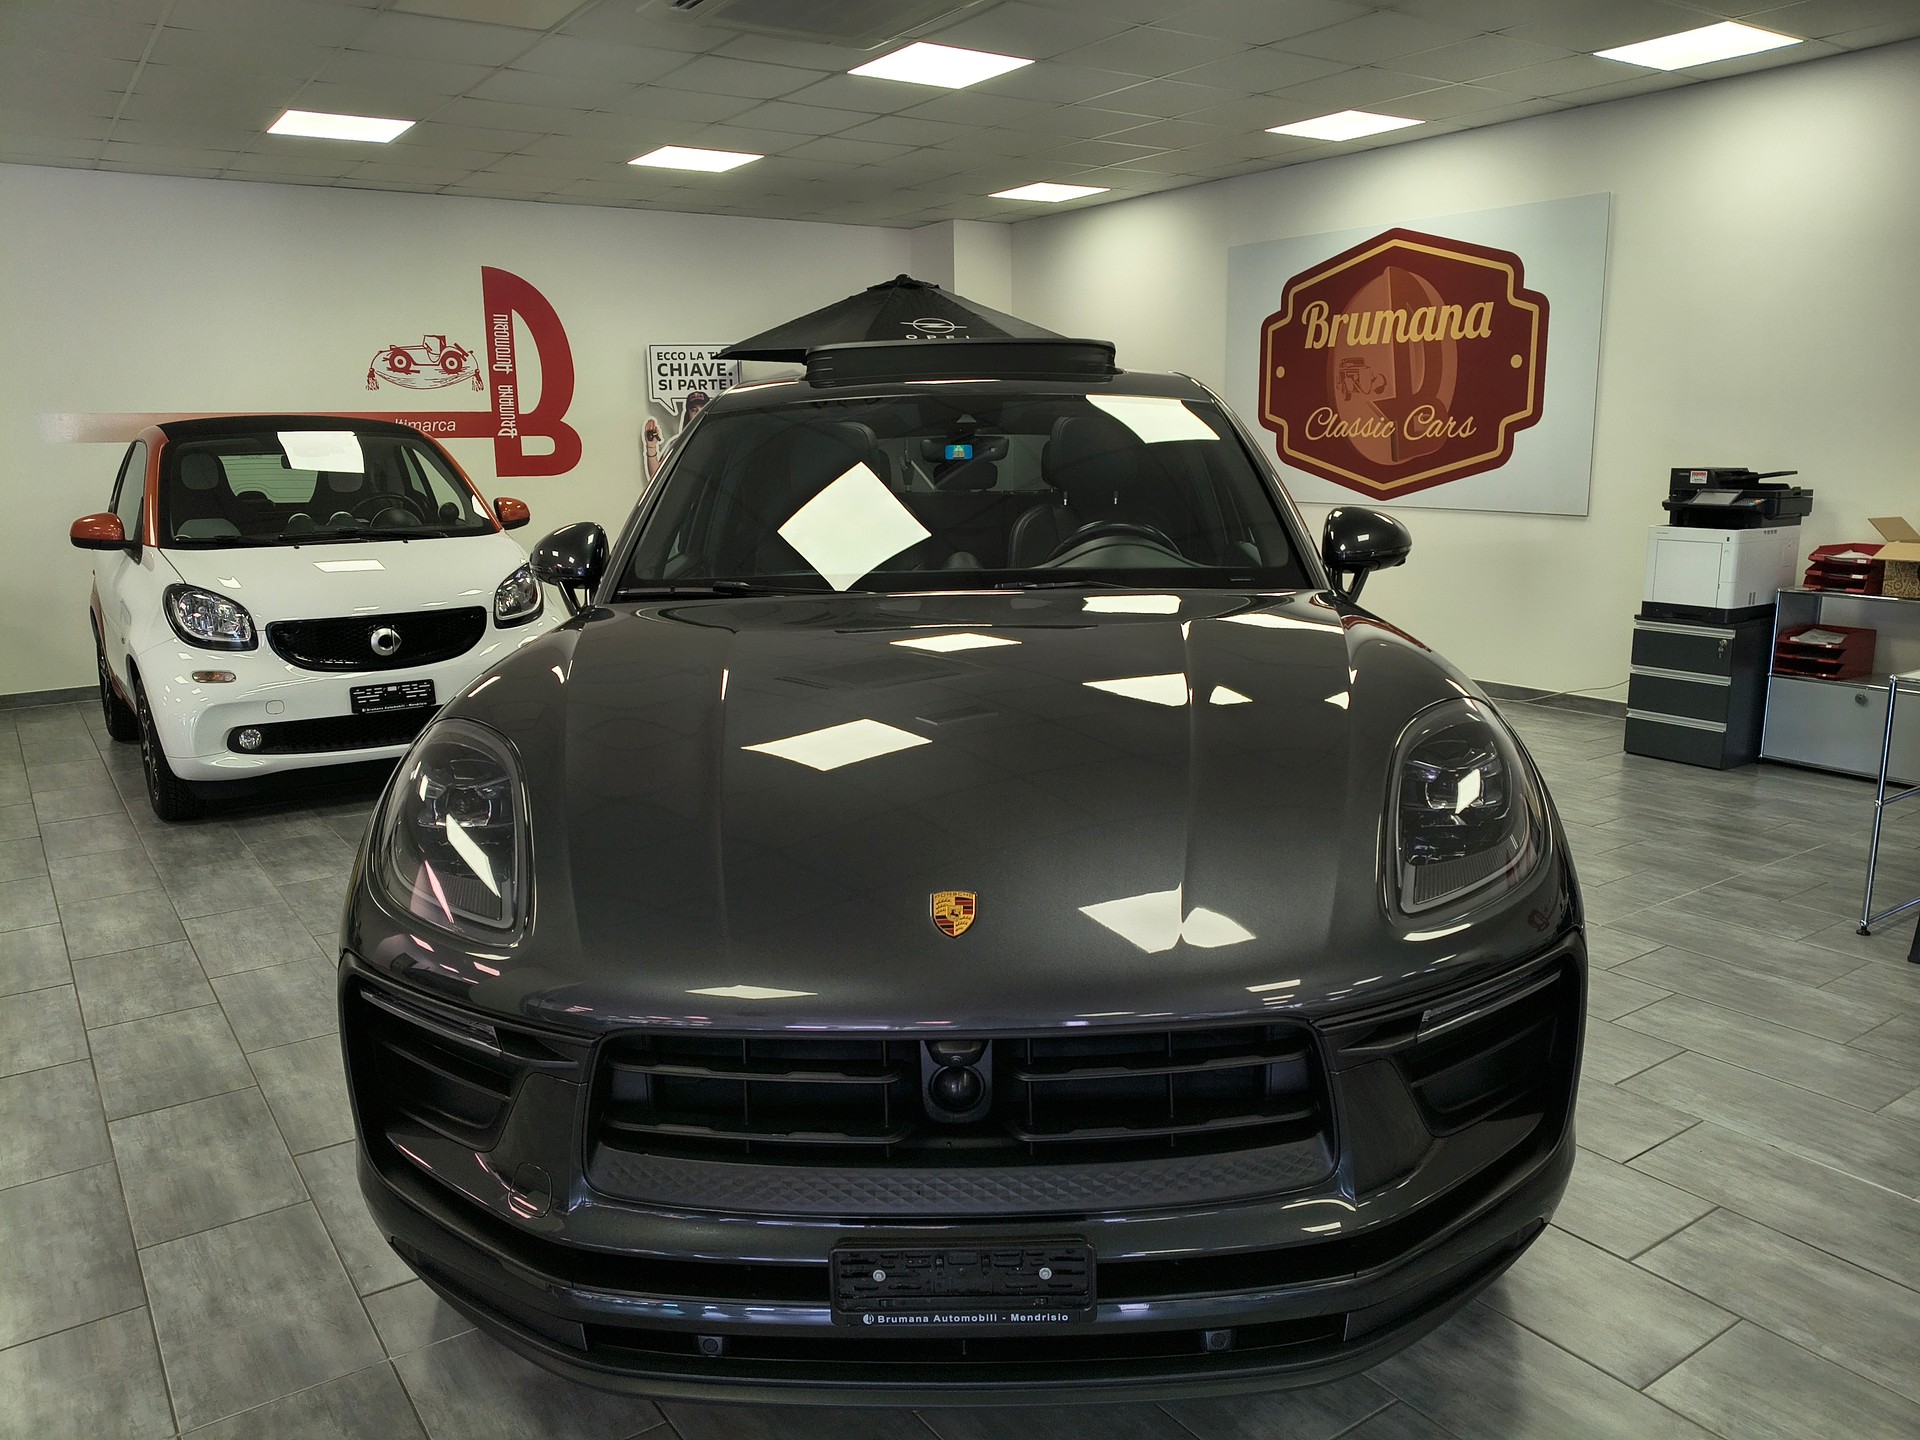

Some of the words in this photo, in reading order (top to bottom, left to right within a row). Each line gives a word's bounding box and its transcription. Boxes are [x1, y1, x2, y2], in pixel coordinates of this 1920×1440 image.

[1301, 300, 1495, 350] Brumana
[656, 351, 686, 361] ECCO
[689, 351, 705, 361] LA
[657, 363, 733, 377] CHIAVE.
[658, 379, 673, 391] SI
[678, 379, 733, 391] PARTE!
[1305, 406, 1396, 441] Classic
[1403, 404, 1477, 441] Cars
[877, 1314, 929, 1324] Brumana
[933, 1313, 998, 1323] Automobili
[1010, 1312, 1069, 1322] Mendrisio
